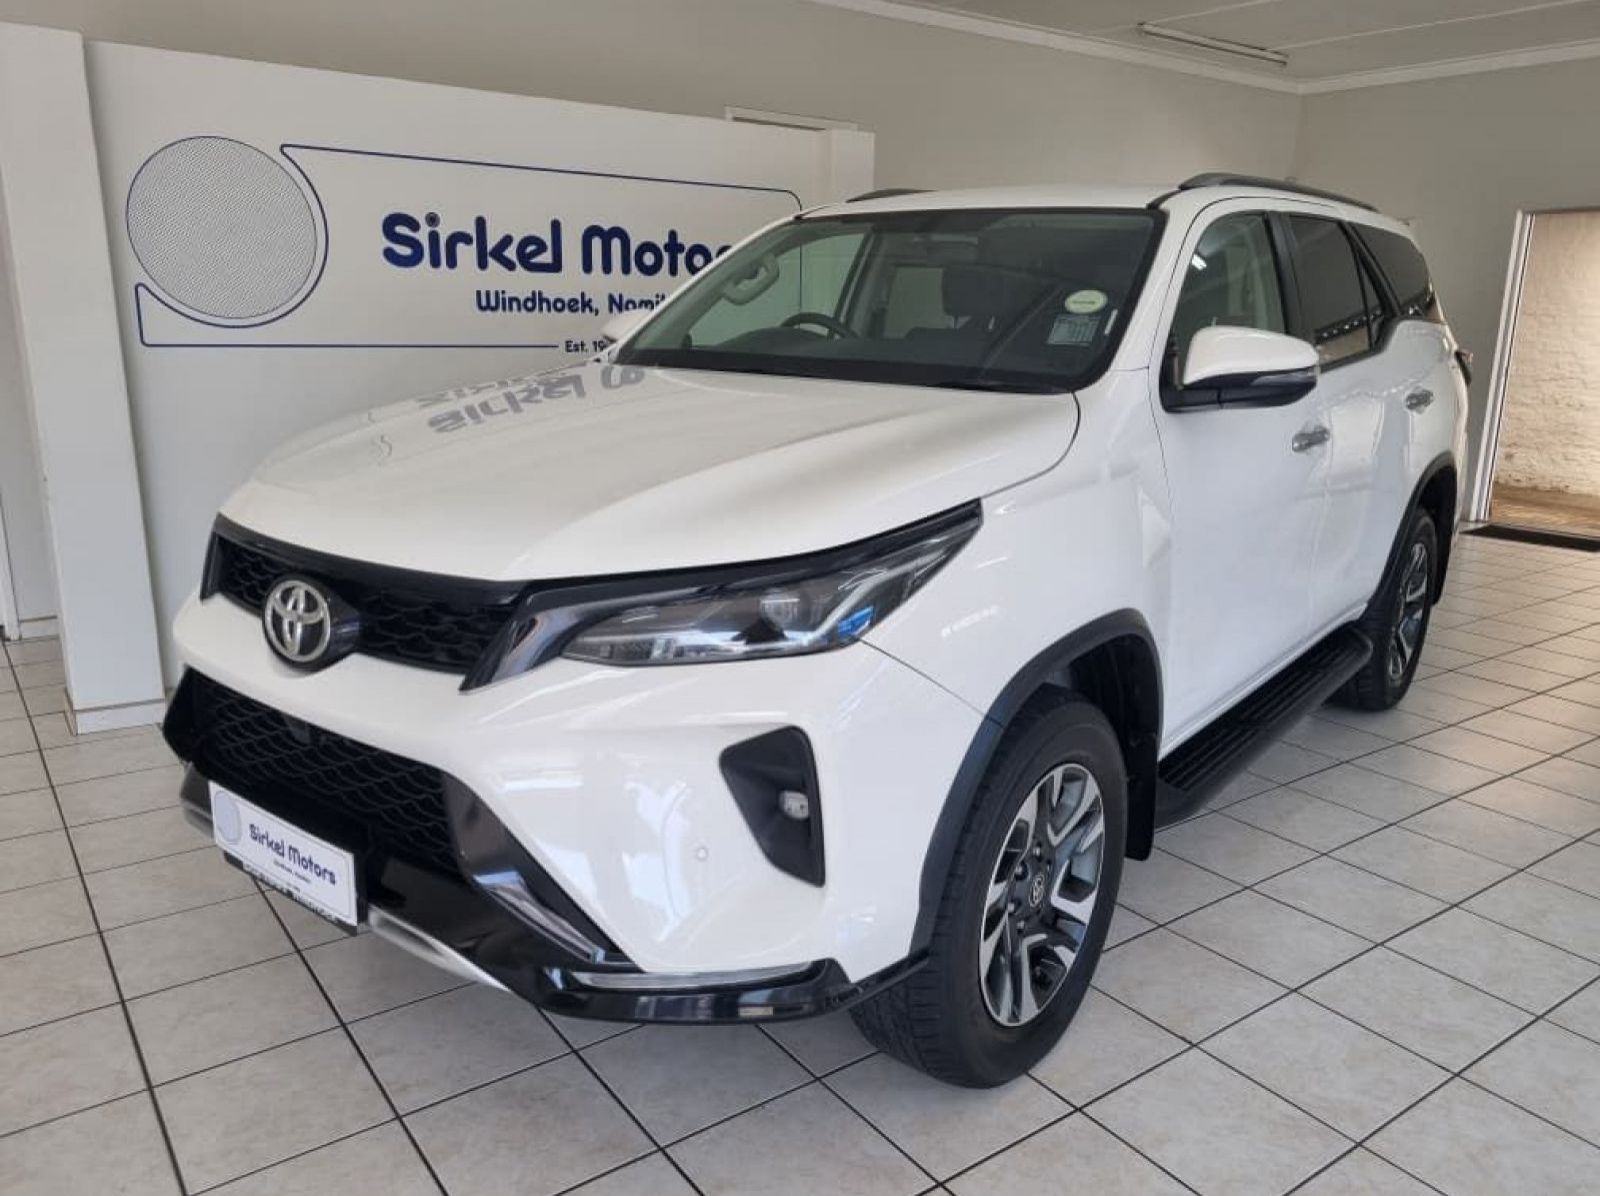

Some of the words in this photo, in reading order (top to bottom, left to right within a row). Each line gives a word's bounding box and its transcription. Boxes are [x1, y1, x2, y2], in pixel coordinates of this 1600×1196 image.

[382, 211, 563, 274] Sirkel
[475, 290, 599, 317] Windhoek,
[565, 340, 589, 353] Est.
[249, 823, 285, 857] Sirkel
[288, 844, 336, 886] Motors
